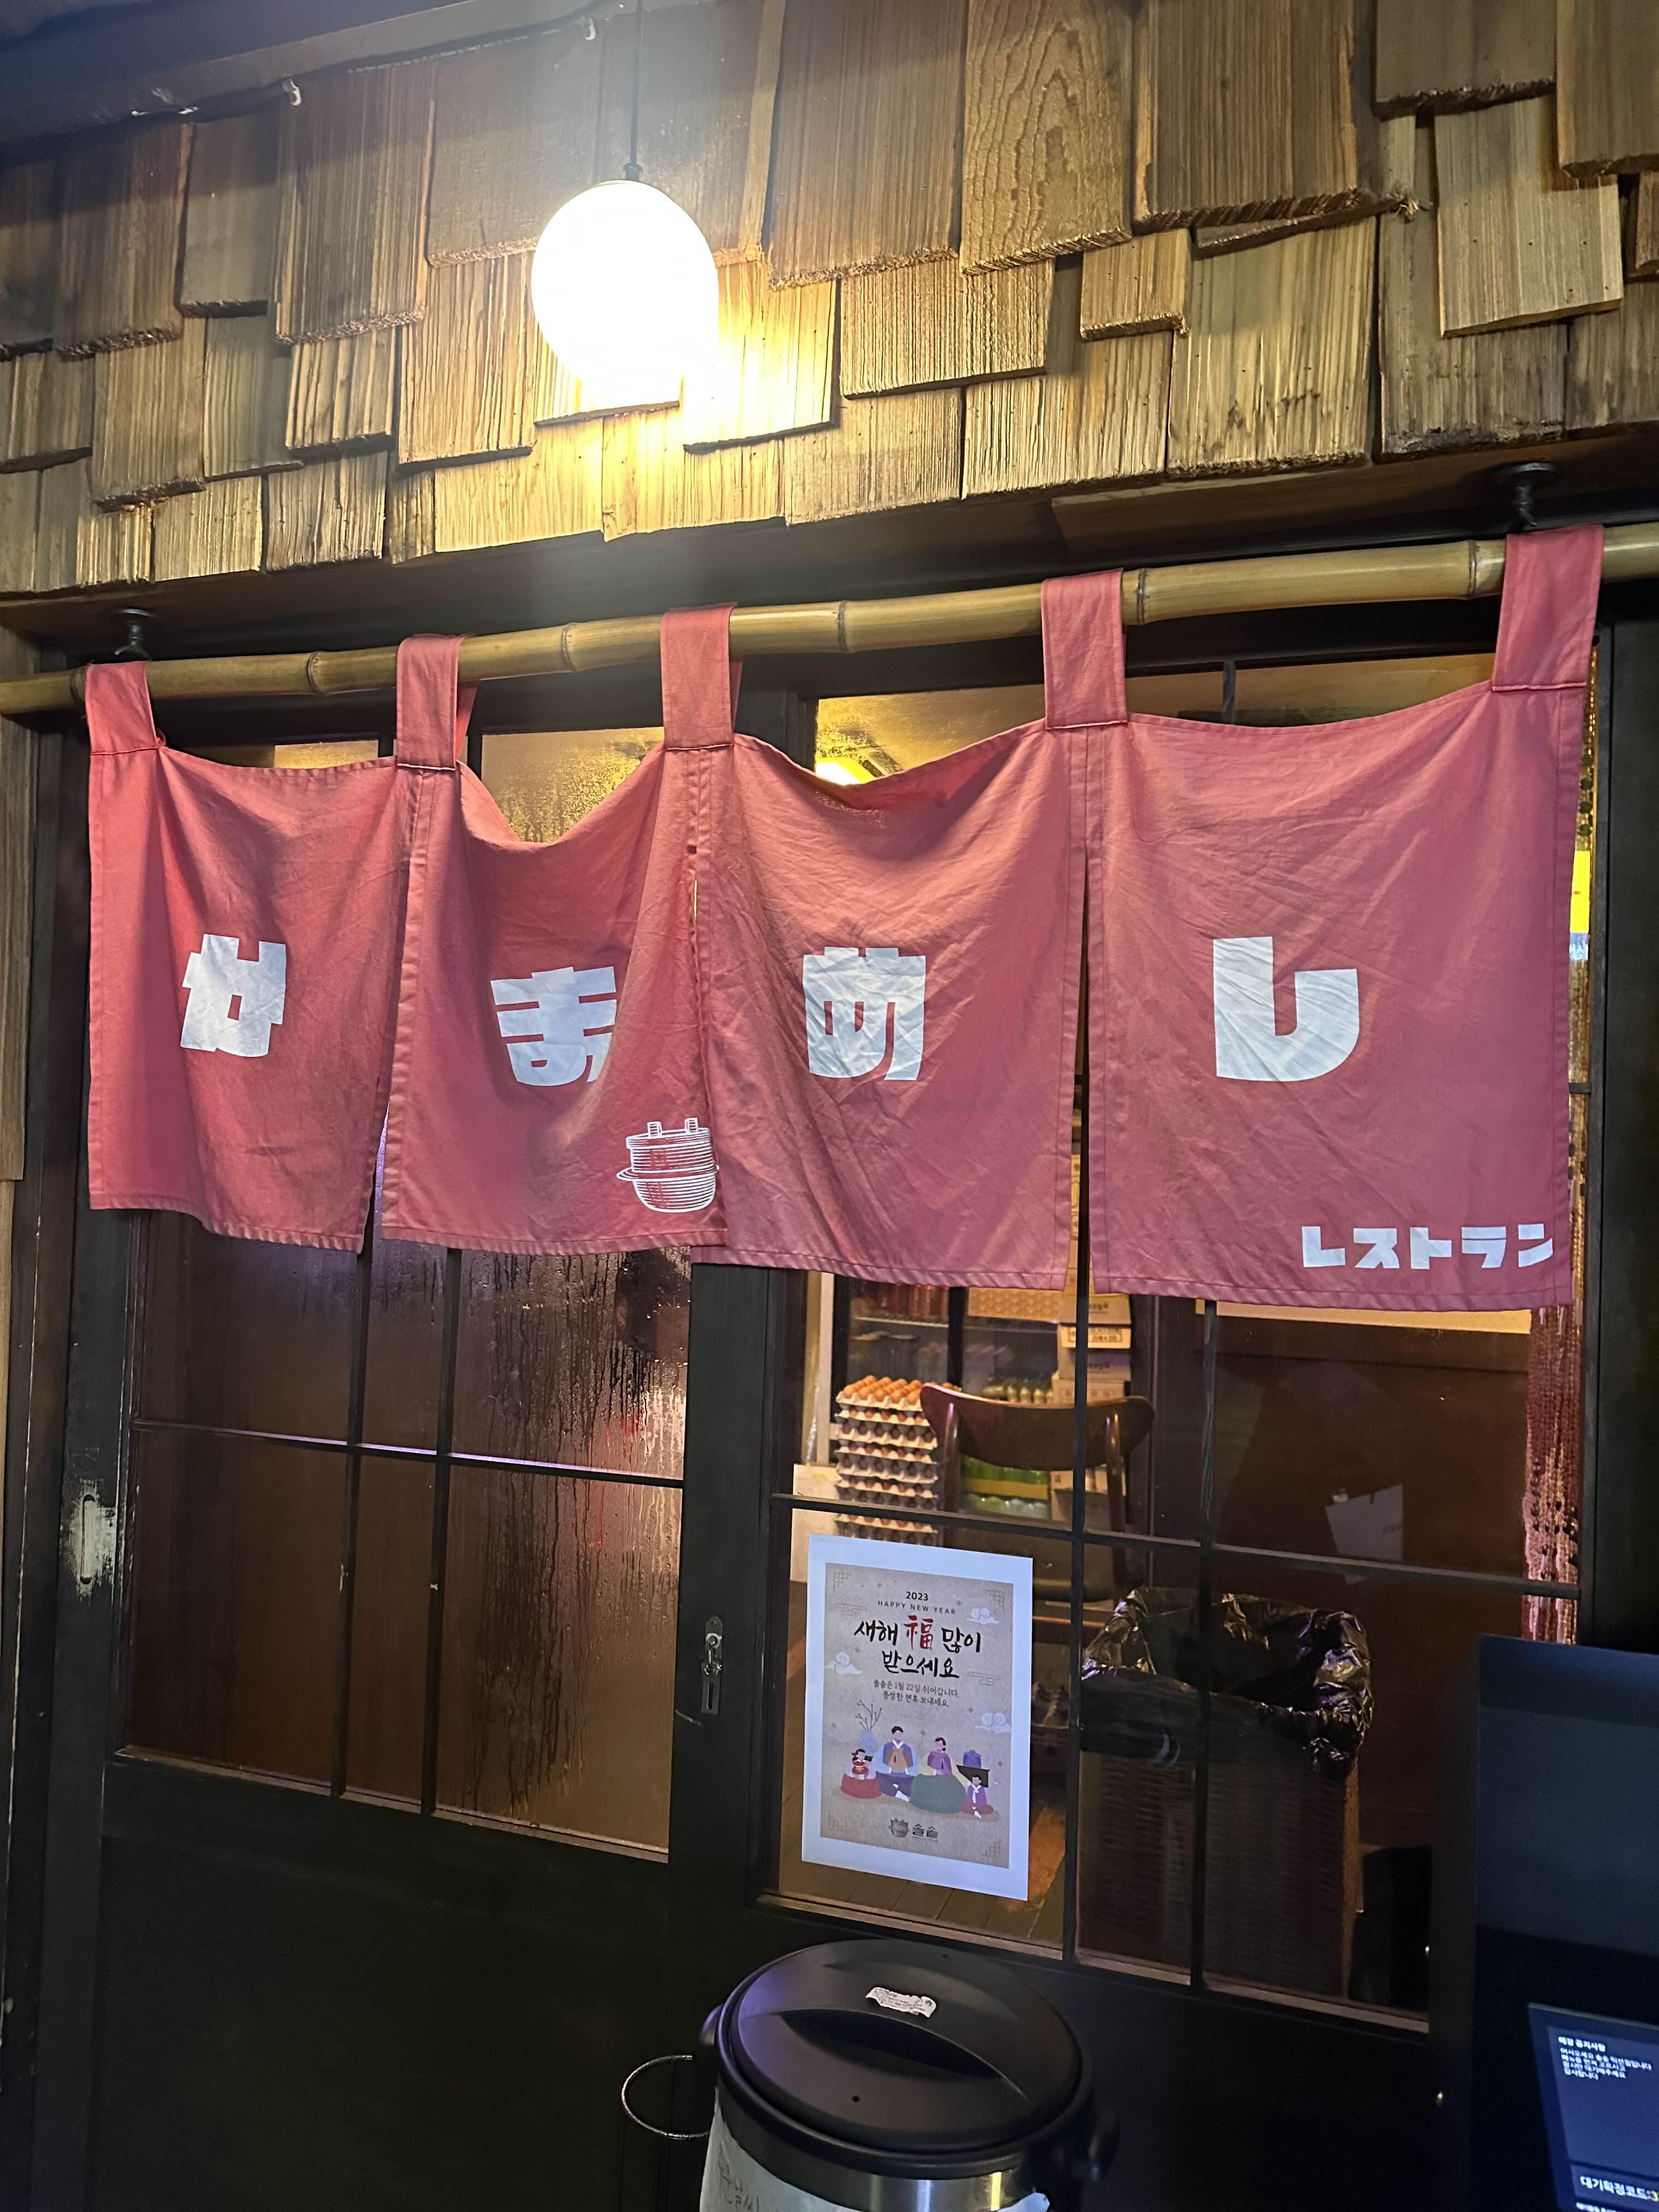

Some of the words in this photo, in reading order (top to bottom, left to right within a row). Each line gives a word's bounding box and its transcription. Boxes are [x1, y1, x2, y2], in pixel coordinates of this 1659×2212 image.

[1301, 1223, 1553, 1270] レストラン
[906, 1591, 928, 1601] 2023
[878, 1600, 905, 1609] HAPPY
[934, 1606, 956, 1615] YEAR
[854, 1620, 898, 1646] 새해
[904, 1615, 933, 1650] 福
[941, 1627, 981, 1654] 많이
[882, 1650, 960, 1678] 받으세요
[883, 1691, 903, 1701] 풍성한
[905, 1694, 918, 1703] 연휴
[895, 1681, 904, 1691] 1월
[906, 1684, 920, 1694] 22일
[922, 1685, 960, 1698] 쉬어갑니다.
[913, 1824, 938, 1838] 솔솥
